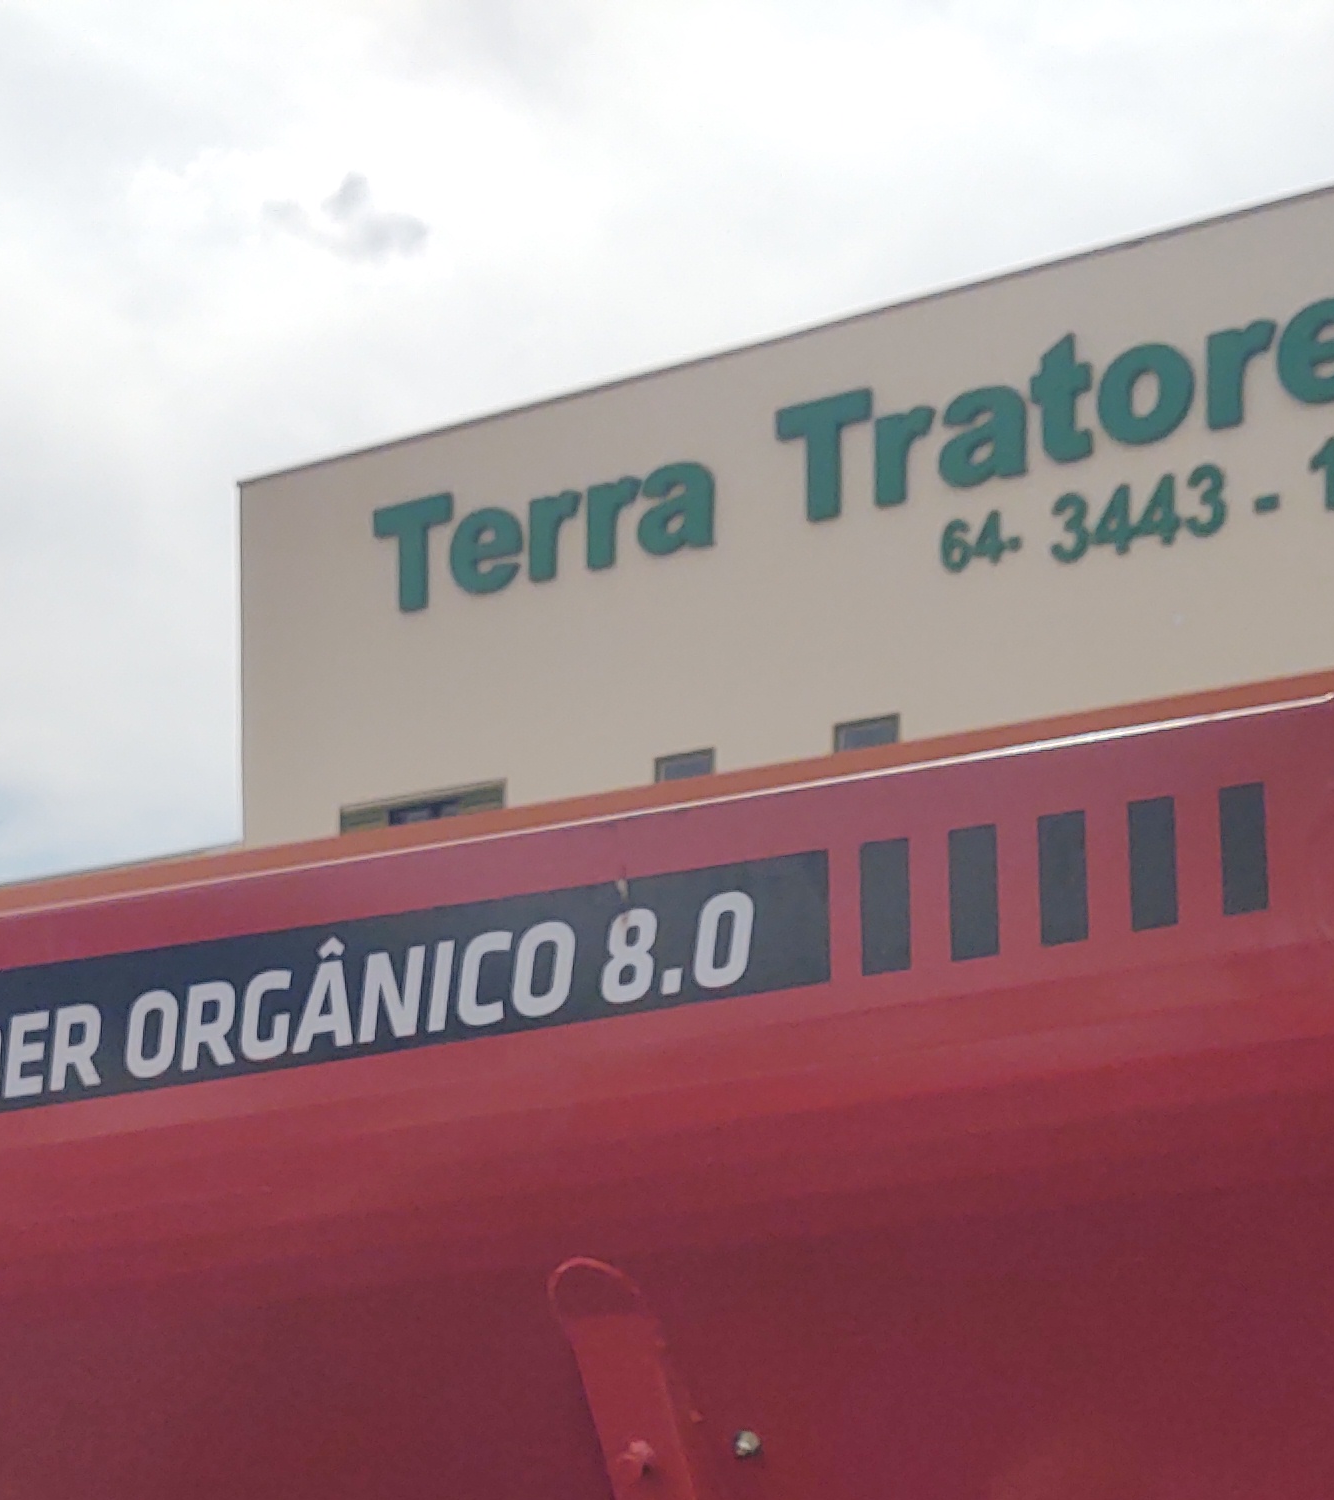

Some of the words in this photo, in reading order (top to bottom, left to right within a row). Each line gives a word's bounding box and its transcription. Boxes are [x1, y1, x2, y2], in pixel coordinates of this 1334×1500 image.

[372, 461, 716, 613] Terra
[1050, 462, 1227, 565] 3443
[124, 921, 576, 1079] ORGÂNICO
[600, 890, 755, 1005] 8.0
